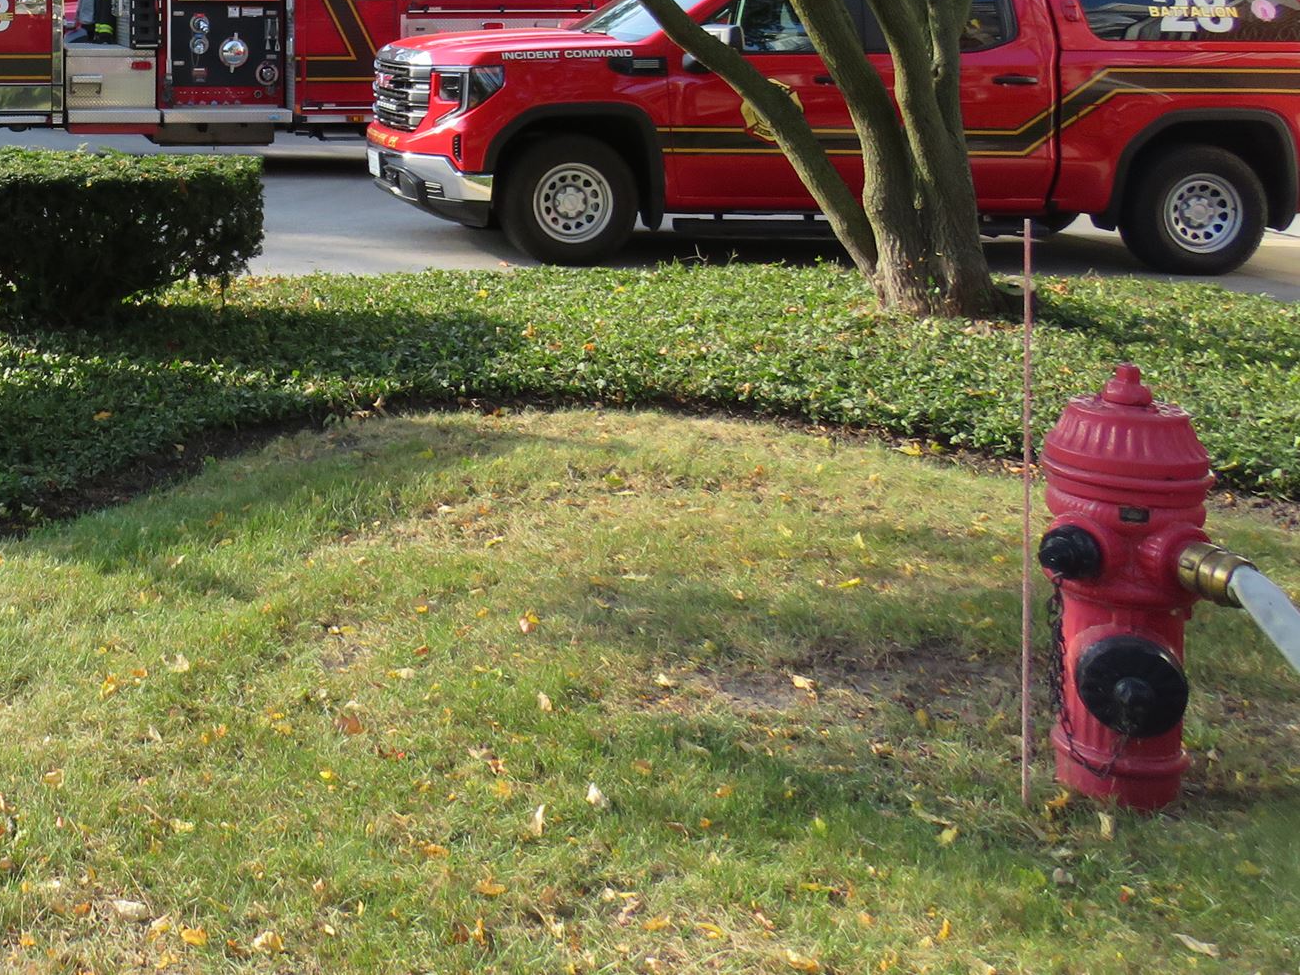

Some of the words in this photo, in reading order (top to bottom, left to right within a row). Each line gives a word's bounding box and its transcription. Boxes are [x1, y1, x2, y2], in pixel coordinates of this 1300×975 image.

[1148, 5, 1239, 18] BATTALION
[501, 50, 560, 60] INCIDENT
[564, 48, 634, 59] COMMAND
